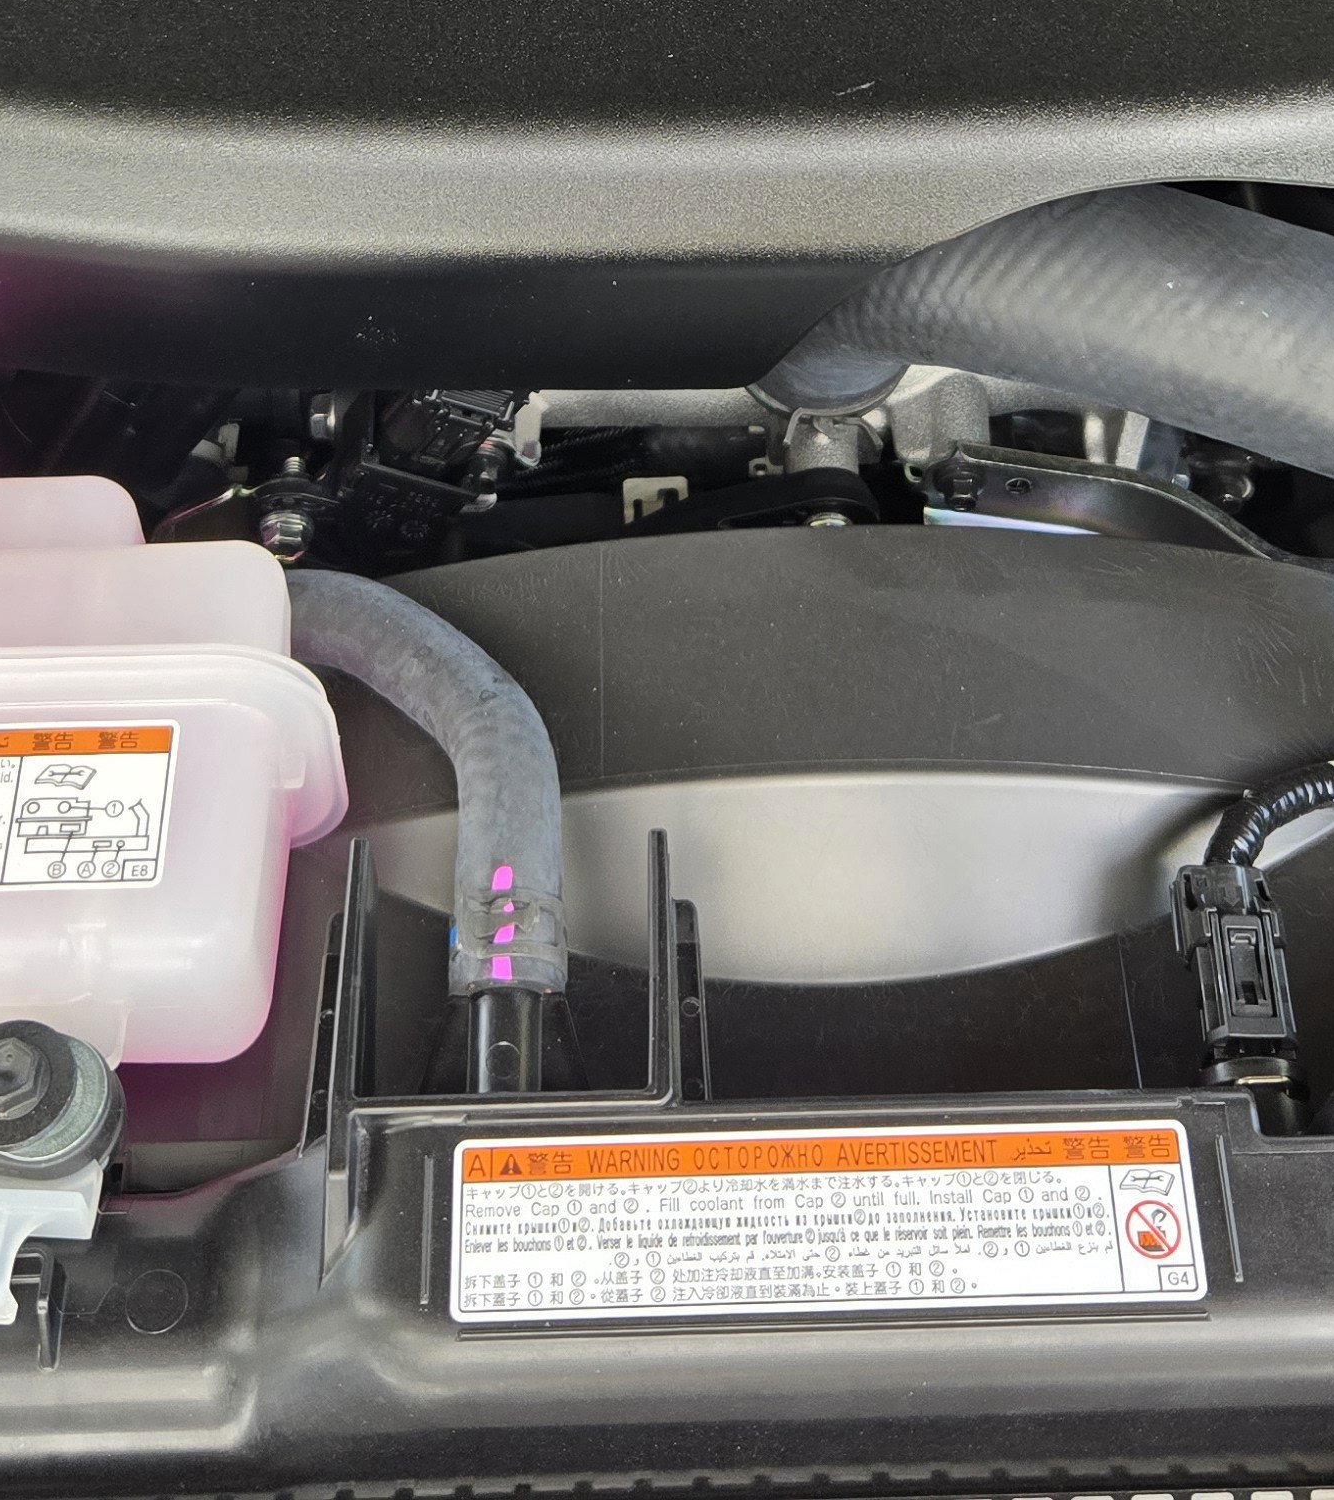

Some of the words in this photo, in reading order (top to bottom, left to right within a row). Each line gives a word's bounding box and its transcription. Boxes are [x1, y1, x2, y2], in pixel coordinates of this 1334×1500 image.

[31, 731, 74, 752] 警告
[97, 730, 140, 750] 警告
[130, 864, 149, 879] E8
[467, 1153, 487, 1178] A
[527, 1151, 574, 1176] 警告
[586, 1147, 680, 1174] WARNING
[693, 1143, 824, 1171] ОСТОРОЖНО
[836, 1139, 998, 1167] AVERTISSEMENT
[1010, 1137, 1053, 1162] تحذير
[1062, 1136, 1110, 1161] 警告
[1122, 1133, 1171, 1159] 警告
[465, 1203, 521, 1218] Remove
[530, 1201, 560, 1218] Cap
[589, 1198, 617, 1215] and
[659, 1196, 680, 1213] Fill
[689, 1195, 744, 1212] coolant
[753, 1194, 785, 1210] from
[794, 1193, 824, 1210] Cap
[852, 1191, 885, 1207] until
[893, 1190, 920, 1206] full.
[929, 1188, 973, 1205] Install
[982, 1188, 1012, 1205] Cap
[1041, 1186, 1069, 1203] and
[464, 1238, 493, 1254] Enlever
[497, 1237, 509, 1253] les
[512, 1236, 552, 1253] bouchons
[566, 1236, 575, 1251] et
[596, 1234, 622, 1250] Verser
[626, 1234, 634, 1249] le
[637, 1233, 664, 1250] liquide
[667, 1232, 678, 1248] de
[681, 1231, 742, 1248] refroidissement
[744, 1233, 759, 1247] par
[762, 1229, 804, 1245] l'ouverture
[849, 1230, 860, 1243] ce
[863, 1230, 879, 1244] que
[882, 1226, 891, 1242] le
[932, 1225, 949, 1241] soit
[951, 1224, 974, 1241] plein.
[976, 1224, 1012, 1239] Remettre
[1015, 1223, 1028, 1238] les
[1031, 1222, 1071, 1238] bouchons
[1084, 1222, 1095, 1236] et
[549, 1272, 564, 1287] 和
[908, 1261, 922, 1277] 和
[1167, 1270, 1190, 1286] G4
